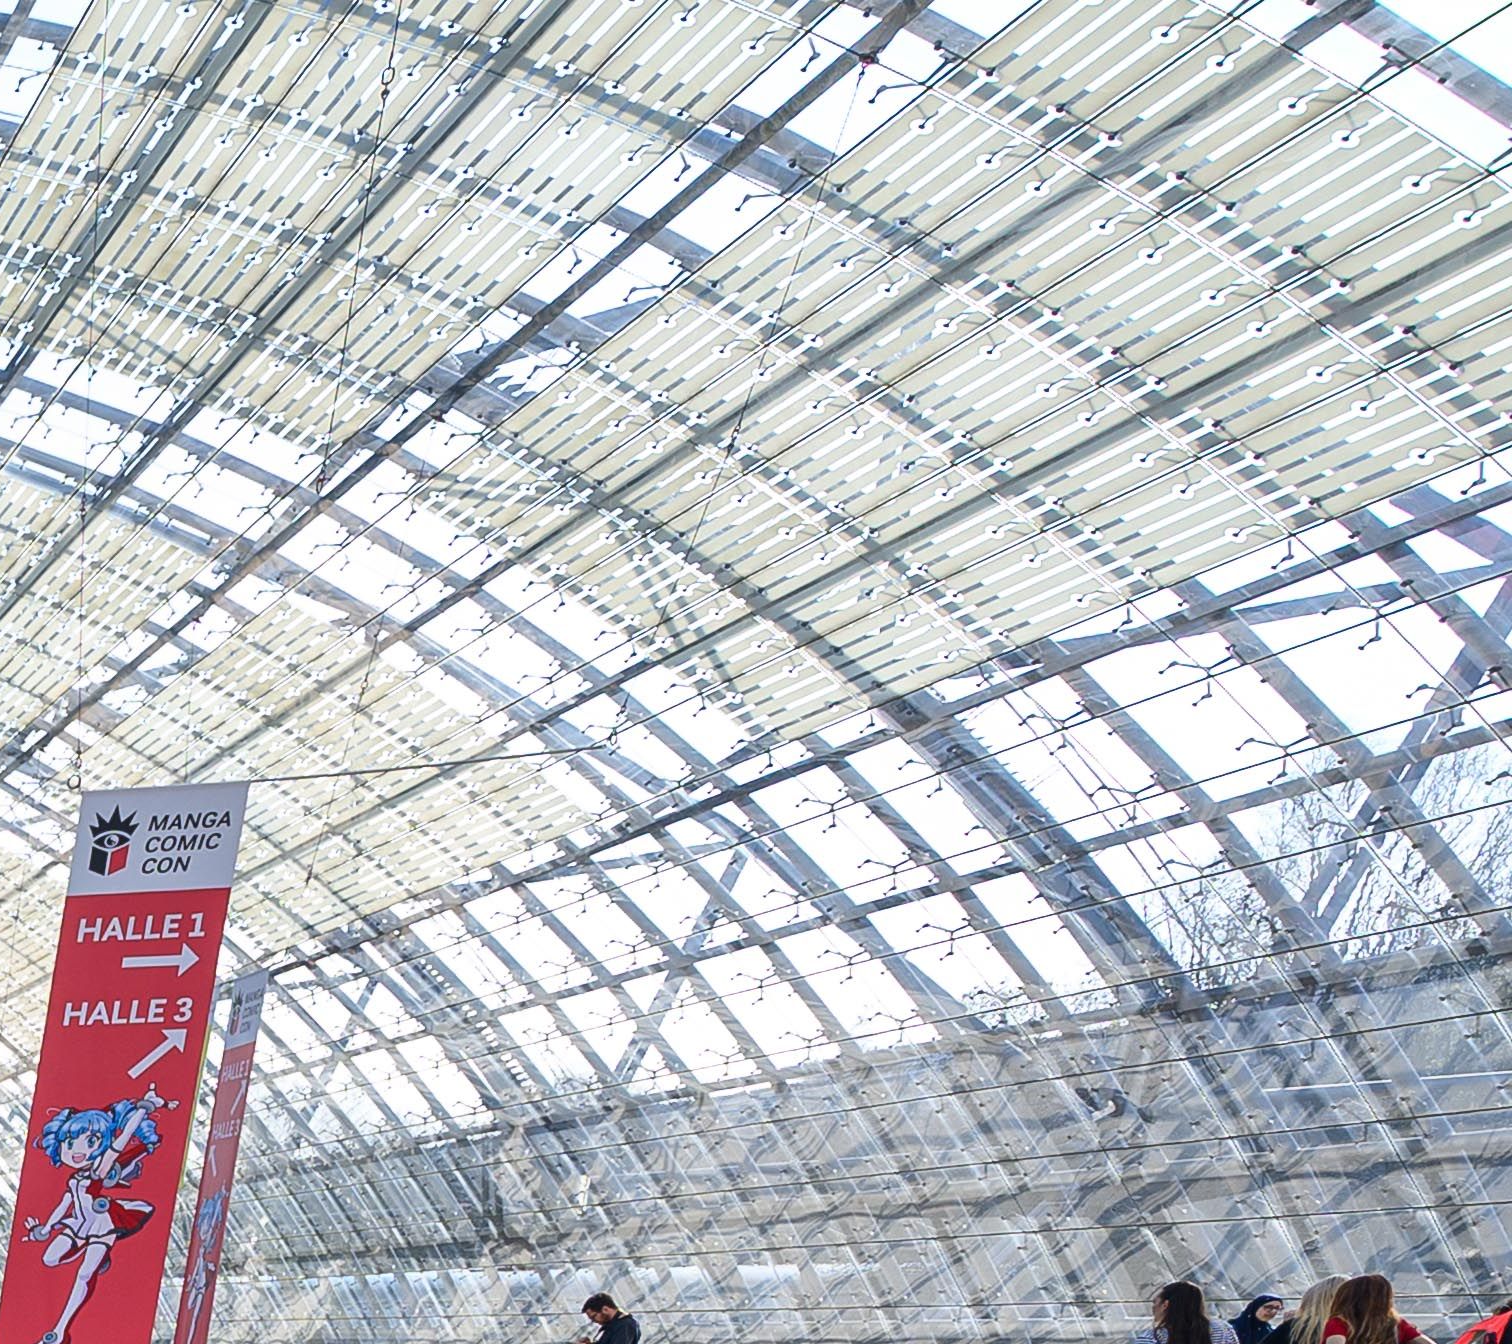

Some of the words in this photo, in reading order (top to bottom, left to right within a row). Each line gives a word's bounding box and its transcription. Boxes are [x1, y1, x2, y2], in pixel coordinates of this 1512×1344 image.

[148, 810, 232, 831] MANGA
[145, 832, 222, 853] COMIC
[141, 856, 192, 875] CON
[76, 913, 182, 943] HALLE
[188, 911, 206, 938] 1
[62, 998, 167, 1026] HALLE
[172, 996, 194, 1022] 3
